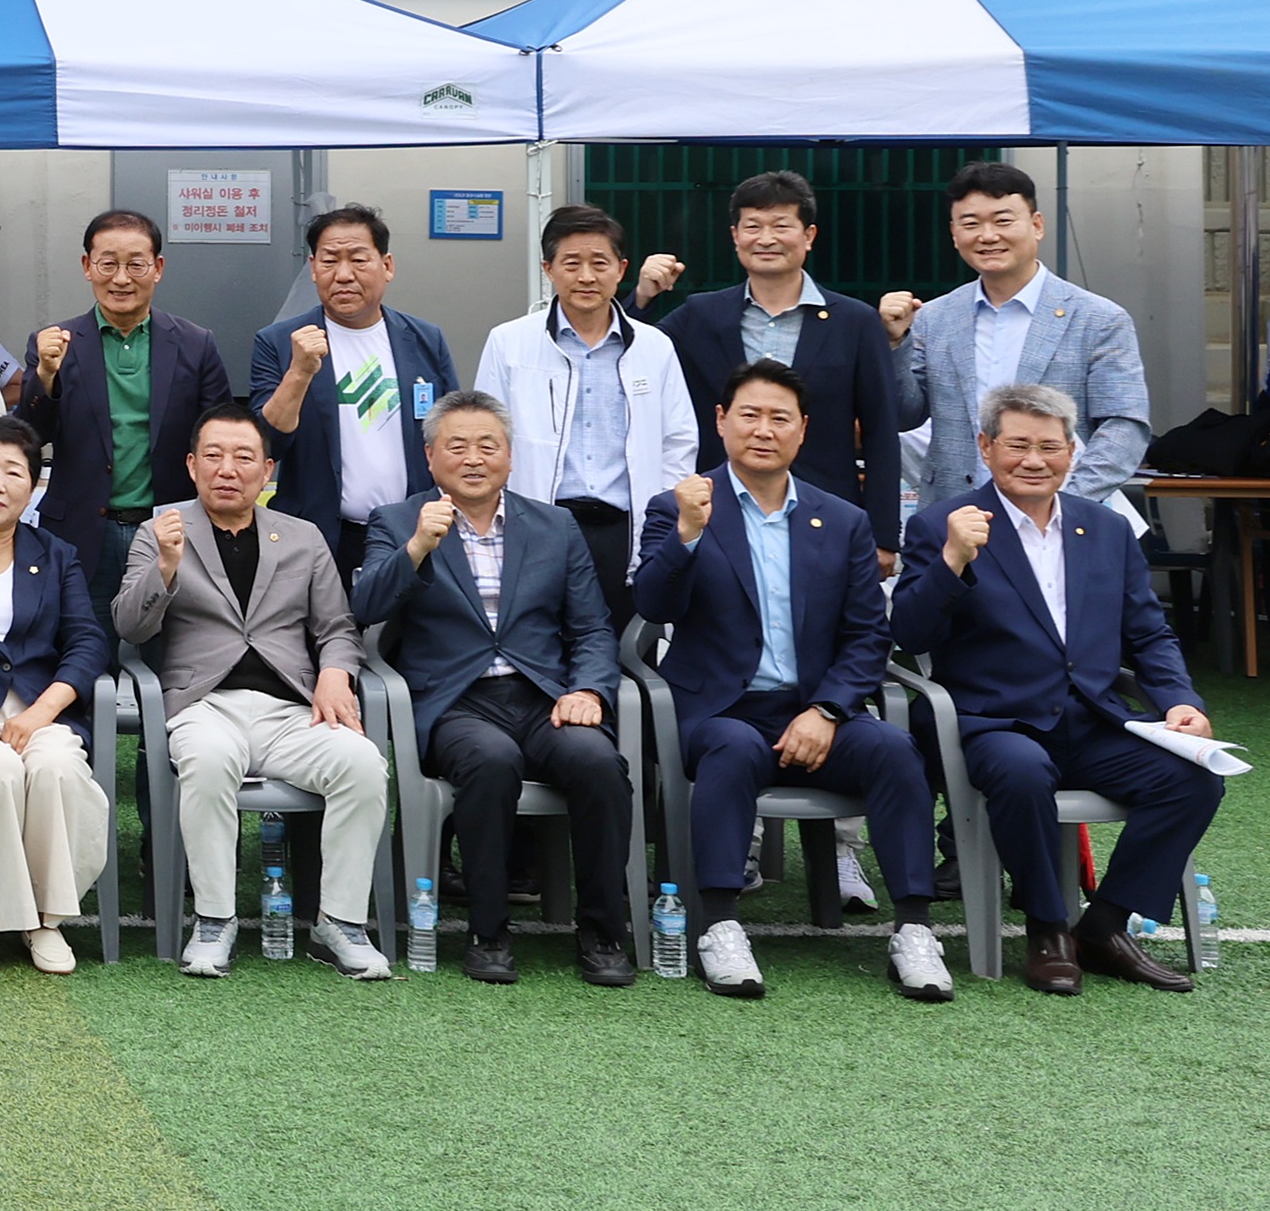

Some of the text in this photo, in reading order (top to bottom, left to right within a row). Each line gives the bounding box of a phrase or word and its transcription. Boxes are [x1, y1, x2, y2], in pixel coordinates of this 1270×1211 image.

[179, 187, 260, 200] 샤워실 이용 후
[182, 205, 257, 218] 정리정돈 철저
[185, 223, 222, 233] 미이행시
[249, 223, 268, 233] 조치
